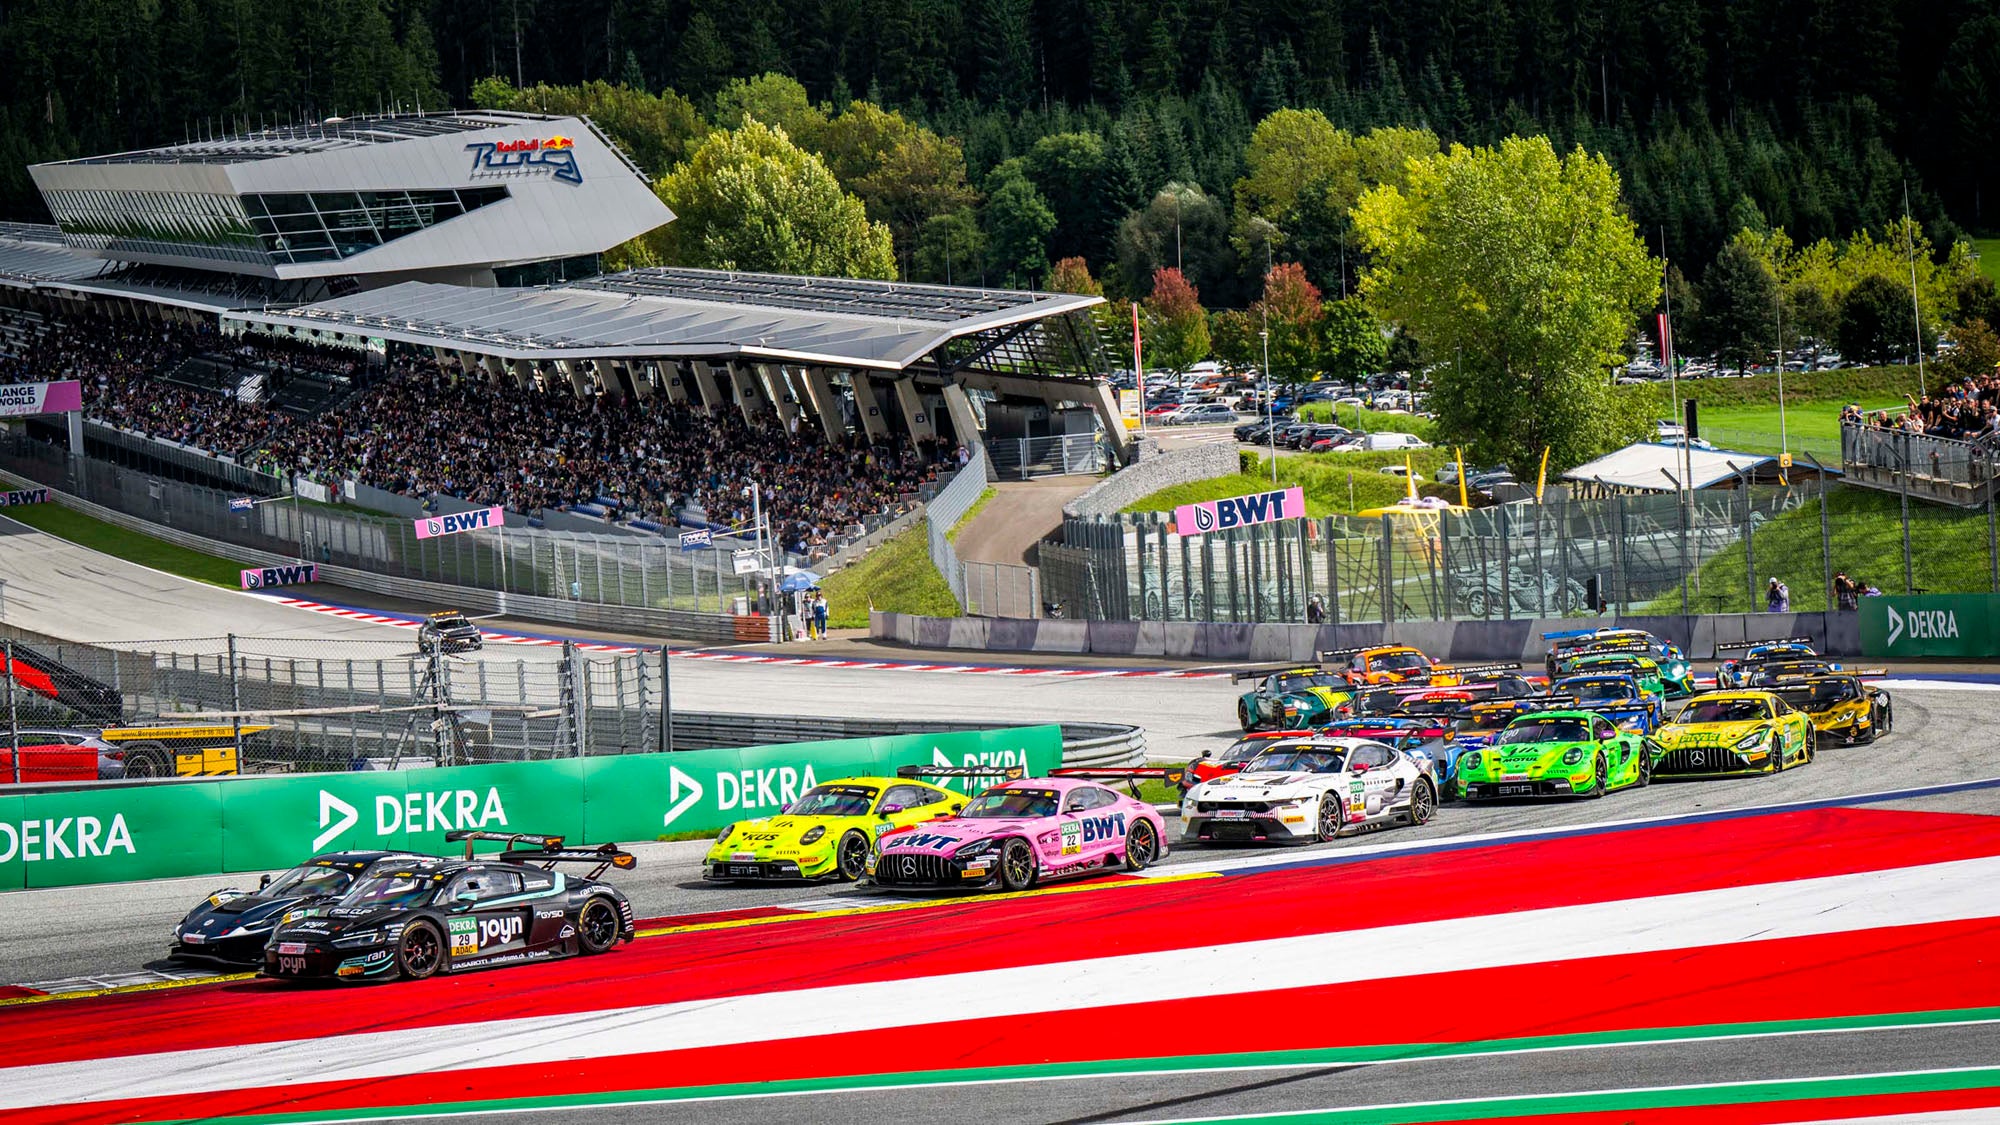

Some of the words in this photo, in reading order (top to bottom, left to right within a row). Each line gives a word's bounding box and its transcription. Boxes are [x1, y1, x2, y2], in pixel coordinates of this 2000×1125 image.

[497, 141, 518, 152] Red
[519, 139, 539, 151] Bull
[9, 489, 48, 505] BWT
[1217, 491, 1285, 528] BWT
[443, 510, 489, 533] BWT
[262, 565, 315, 586] BWT
[1908, 610, 1959, 638] DEKRA
[717, 764, 817, 811] DEKRA
[377, 787, 508, 835] DEKRA
[1061, 822, 1080, 833] DEKRA
[1082, 813, 1126, 843] BWT
[0, 813, 136, 862] DEKRA
[886, 834, 961, 850] BWT
[1067, 835, 1076, 846] 22
[449, 921, 477, 932] DEKRA
[479, 916, 523, 947] joyn
[456, 945, 473, 955] ADAC
[459, 935, 470, 946] 29
[278, 956, 306, 974] joyn
